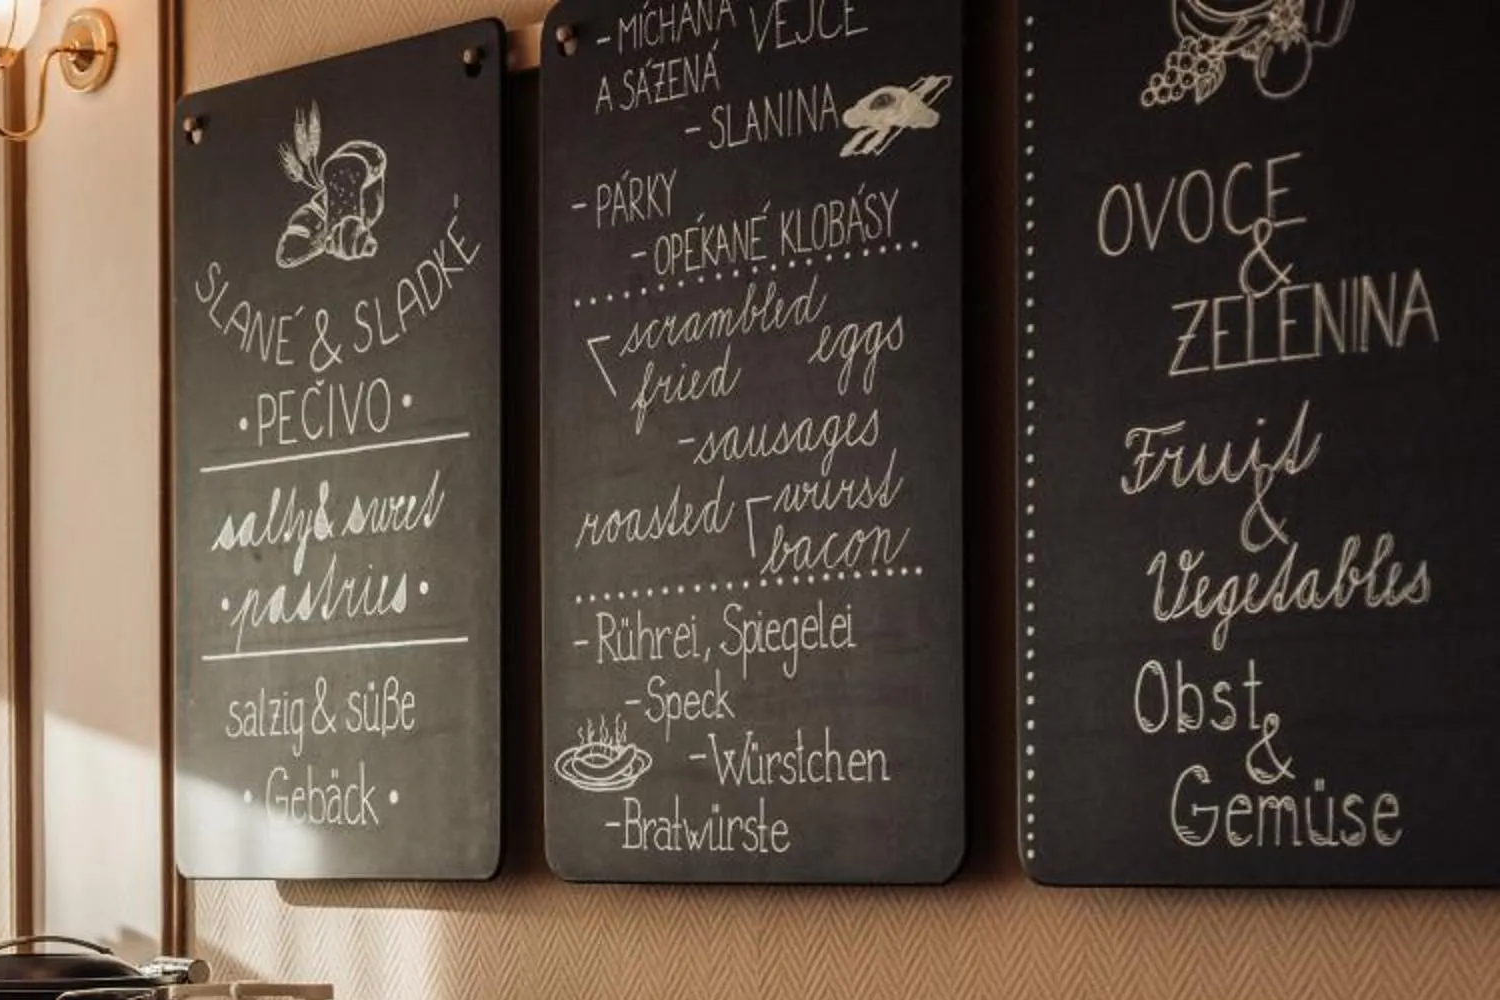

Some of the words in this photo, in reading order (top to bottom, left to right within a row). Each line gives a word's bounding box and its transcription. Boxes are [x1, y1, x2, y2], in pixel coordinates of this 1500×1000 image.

[596, 76, 613, 114] A
[619, 38, 721, 110] SÁZENÁ
[781, 182, 899, 256] KLOBÁSY
[1099, 151, 1307, 257] OVOCE
[196, 262, 304, 365] SLANÉ
[310, 309, 342, 372] &
[354, 193, 482, 353] SLADKÉ
[1238, 217, 1293, 300] &
[619, 274, 828, 358] scrambled
[1168, 268, 1440, 376] ZELENINA
[257, 378, 392, 448] PEČIVO
[631, 344, 742, 435] fried
[808, 314, 904, 396] eggs
[1120, 399, 1324, 496] Fruit
[211, 487, 313, 577] salty
[341, 469, 446, 538] sweet
[575, 475, 735, 551] roasted
[773, 447, 904, 513] wurst
[1239, 463, 1290, 553] &
[760, 526, 912, 576] bacon
[1146, 532, 1432, 651] Vegetables
[230, 551, 408, 653] pastries
[719, 599, 858, 681] Spiegelei
[225, 687, 304, 759] salzig
[311, 676, 337, 735] &
[346, 676, 417, 738] süße
[1135, 658, 1264, 735] Obst
[1245, 713, 1296, 785] &
[265, 760, 379, 826] Gebäck
[1171, 765, 1402, 848] Gemüse
